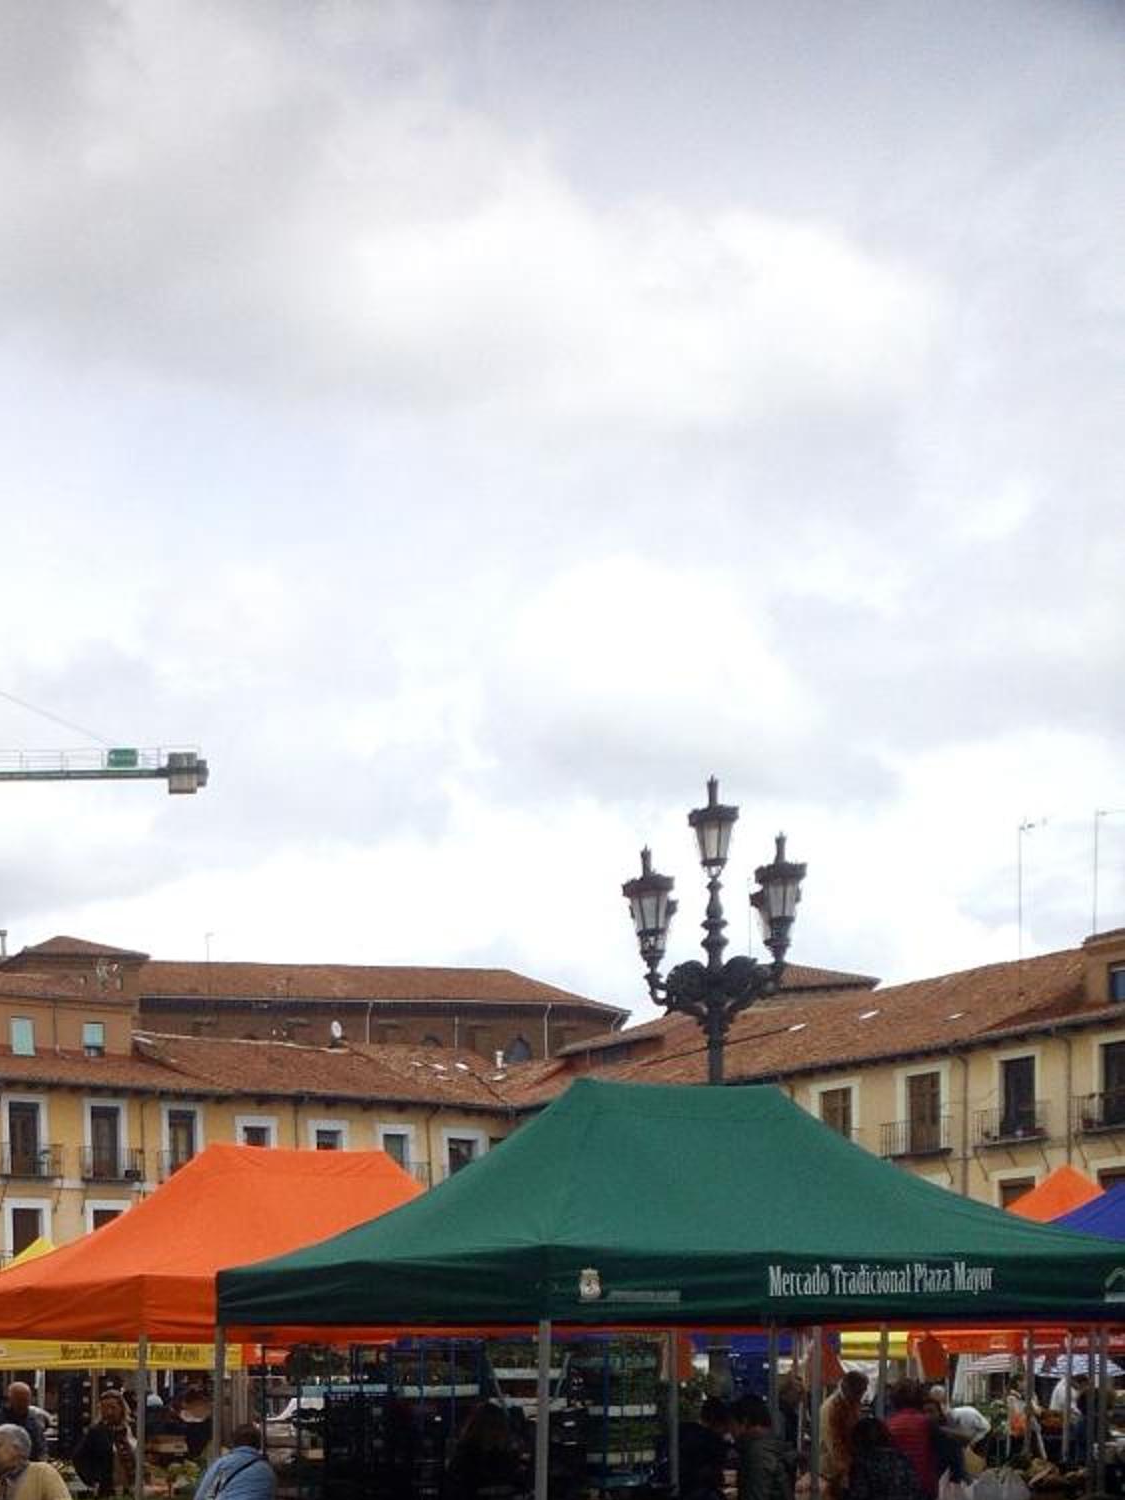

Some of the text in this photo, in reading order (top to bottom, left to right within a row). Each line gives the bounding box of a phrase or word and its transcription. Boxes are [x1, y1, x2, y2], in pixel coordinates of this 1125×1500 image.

[768, 1261, 994, 1297] Mercado Tradicional Plaza Mayor
[60, 1343, 100, 1361] Mercado
